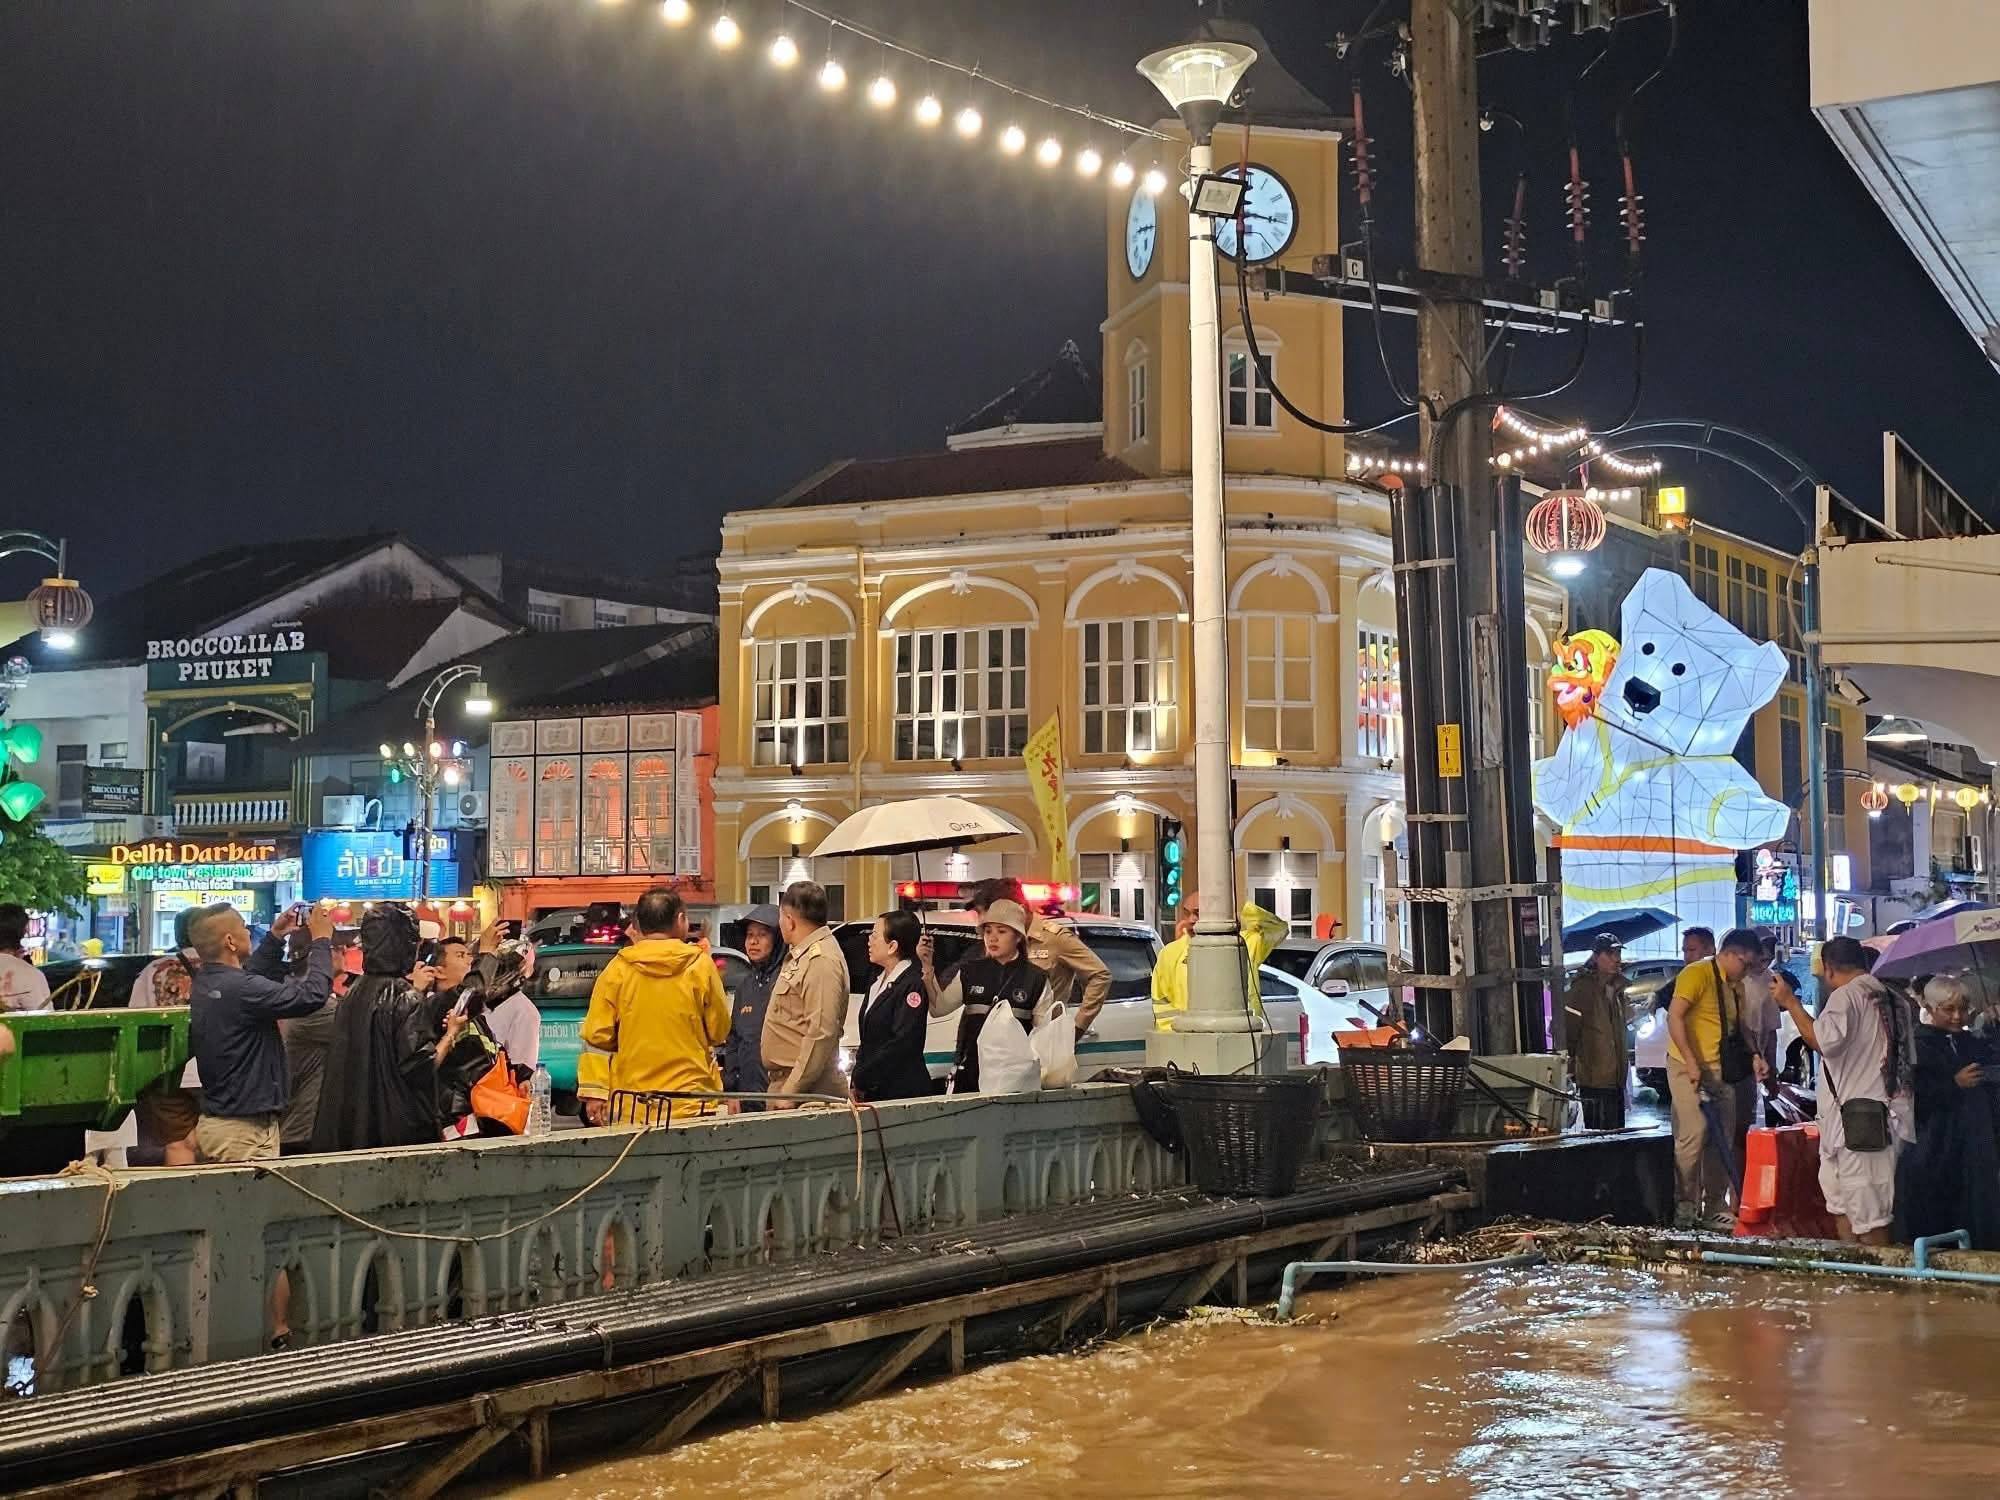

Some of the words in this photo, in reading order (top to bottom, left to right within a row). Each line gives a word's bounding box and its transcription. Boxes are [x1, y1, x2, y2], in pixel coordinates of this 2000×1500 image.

[1351, 261, 1358, 276] C
[146, 631, 305, 659] BROCCOLILAB
[178, 658, 272, 681] PHUKET
[111, 842, 176, 864] Delhi
[181, 842, 276, 863] Darbar
[131, 865, 154, 881] Old
[192, 864, 253, 879] restaurant
[210, 879, 234, 890] food
